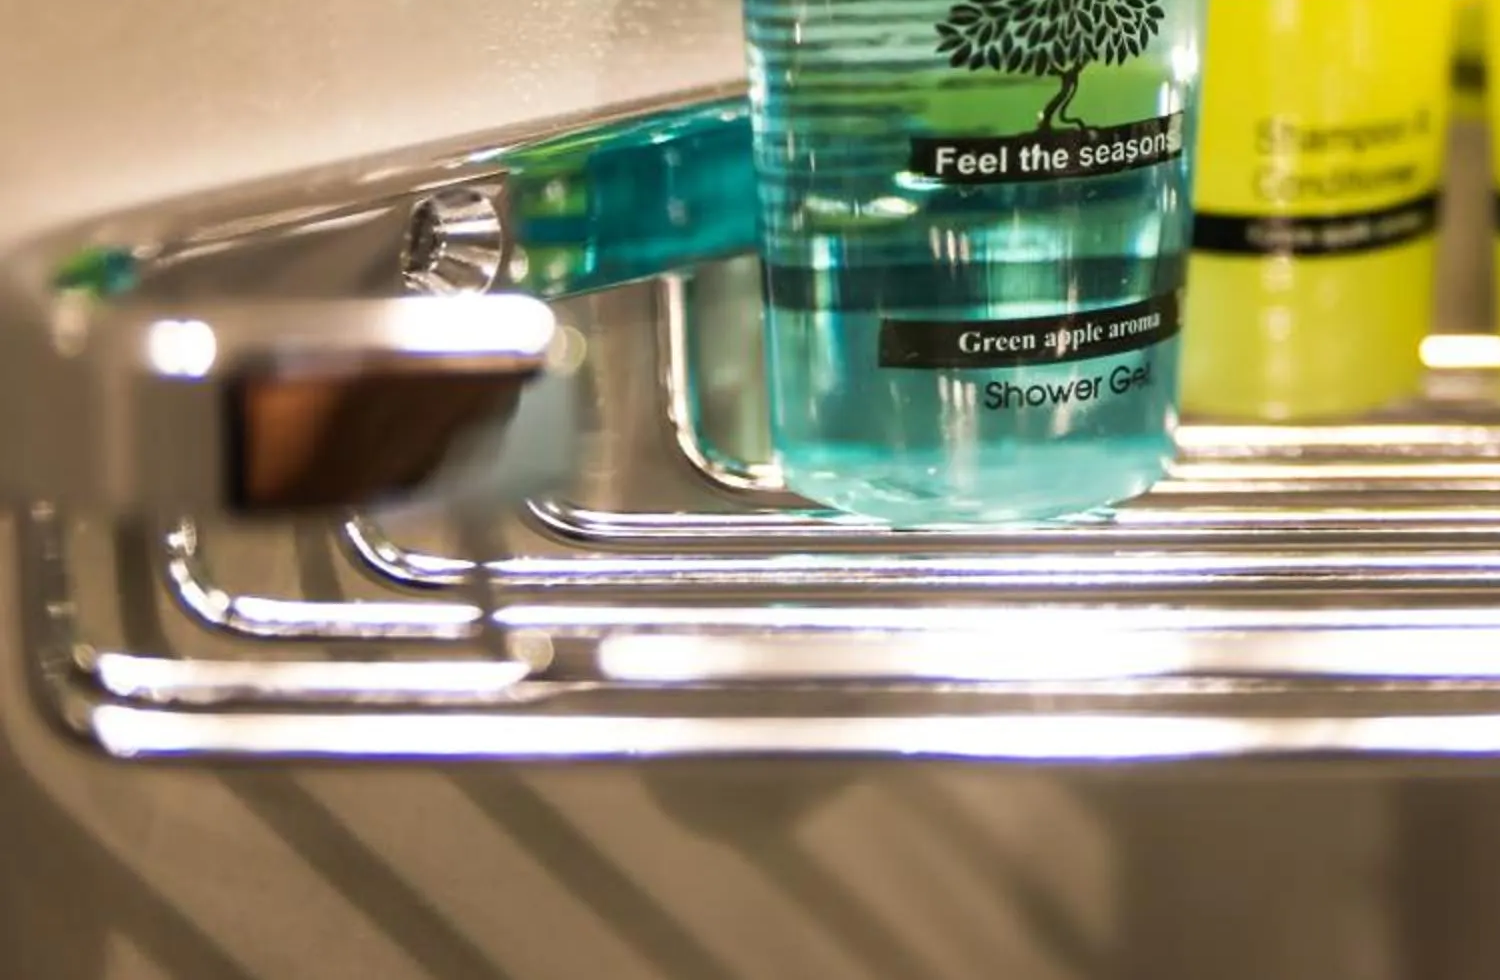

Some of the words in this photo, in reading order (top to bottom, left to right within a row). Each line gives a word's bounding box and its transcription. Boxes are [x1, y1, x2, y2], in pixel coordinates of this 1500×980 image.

[934, 145, 1008, 175] Feel
[1018, 142, 1070, 171] the
[1078, 129, 1181, 168] seasons
[957, 330, 1036, 354] Green
[1043, 322, 1103, 354] apple
[1108, 310, 1161, 339] aroma
[983, 374, 1104, 411] Shower
